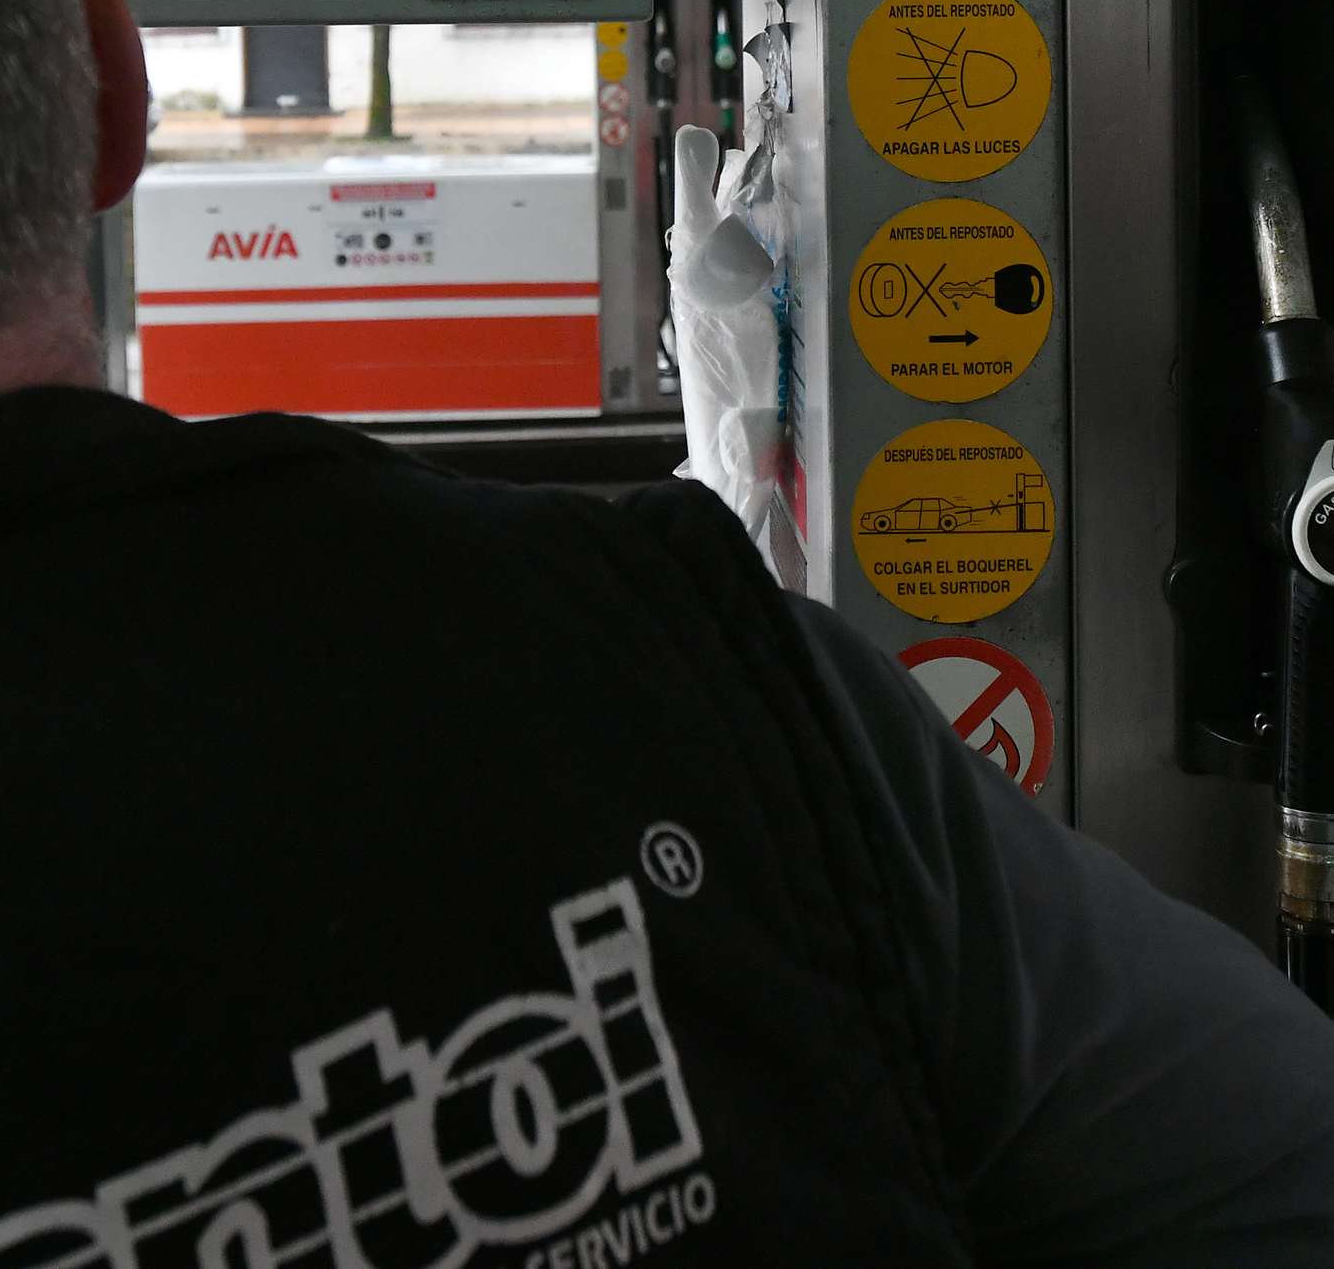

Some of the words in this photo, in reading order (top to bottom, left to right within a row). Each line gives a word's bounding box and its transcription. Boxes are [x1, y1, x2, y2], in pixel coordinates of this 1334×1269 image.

[888, 5, 924, 19] ANTES
[927, 4, 948, 18] DEL
[950, 3, 1016, 18] REPOSTADO
[882, 141, 940, 156] APAGAR
[943, 141, 971, 155] LAS
[974, 139, 1021, 154] LUCES
[889, 227, 925, 241] ANTES
[927, 226, 948, 240] DEL
[950, 225, 1015, 240] REPOSTADO
[207, 224, 300, 261] AVIA
[890, 362, 938, 377] PARAR
[942, 362, 960, 376] EL
[963, 361, 1013, 375] MOTOR
[884, 445, 934, 463] DESPUÉS
[936, 448, 957, 462] DEL
[959, 446, 1024, 461] REPOSTADO
[873, 561, 933, 576] COLGAR
[936, 560, 954, 574] EL
[956, 558, 1033, 575] BOQUEREL
[897, 582, 916, 596] EN
[919, 581, 937, 595] EL
[940, 580, 1011, 595] SURTIDOR
